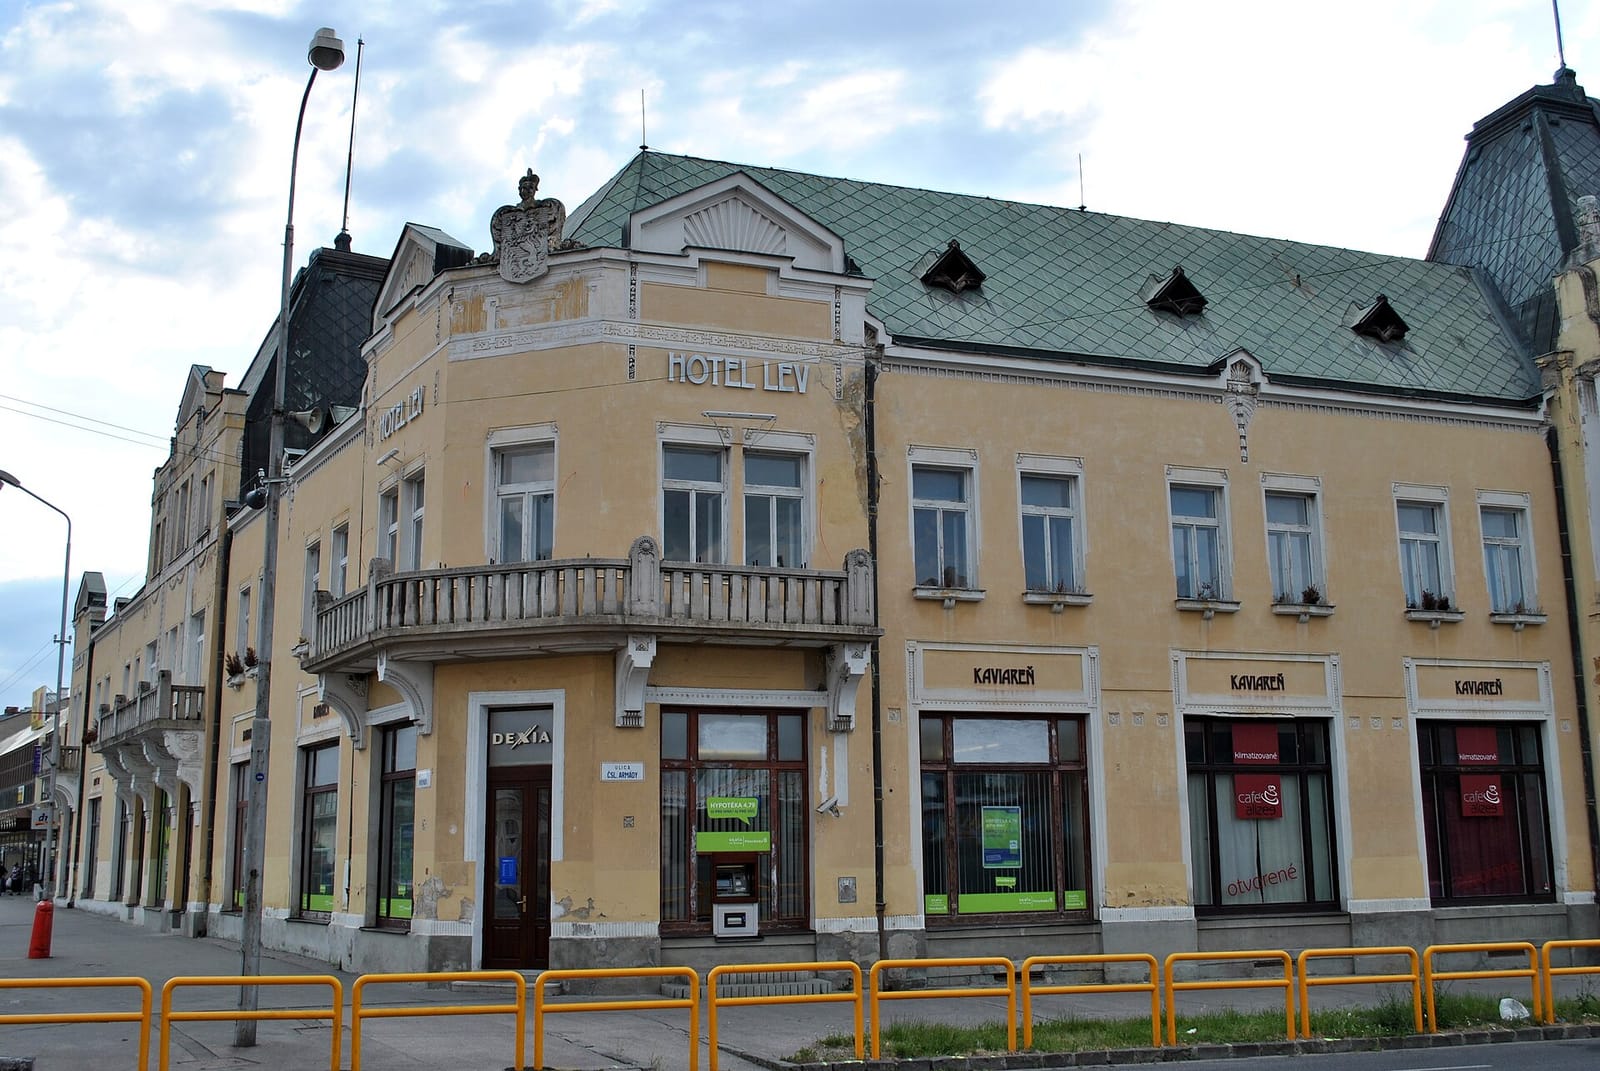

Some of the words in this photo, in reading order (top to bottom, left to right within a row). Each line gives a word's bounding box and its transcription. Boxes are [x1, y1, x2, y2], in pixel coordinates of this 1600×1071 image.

[667, 351, 756, 390] HOTEL
[763, 360, 810, 394] LEV
[378, 399, 407, 443] HOTEL
[407, 385, 424, 421] LEV
[973, 665, 1035, 686] KAVIAREŇ
[1230, 673, 1285, 691] KAVIAREŇ
[1454, 678, 1503, 695] KAVIAREŇ
[492, 724, 551, 750] DEXIA
[1234, 751, 1278, 760] klimatizované
[1227, 863, 1298, 896] otvorené
